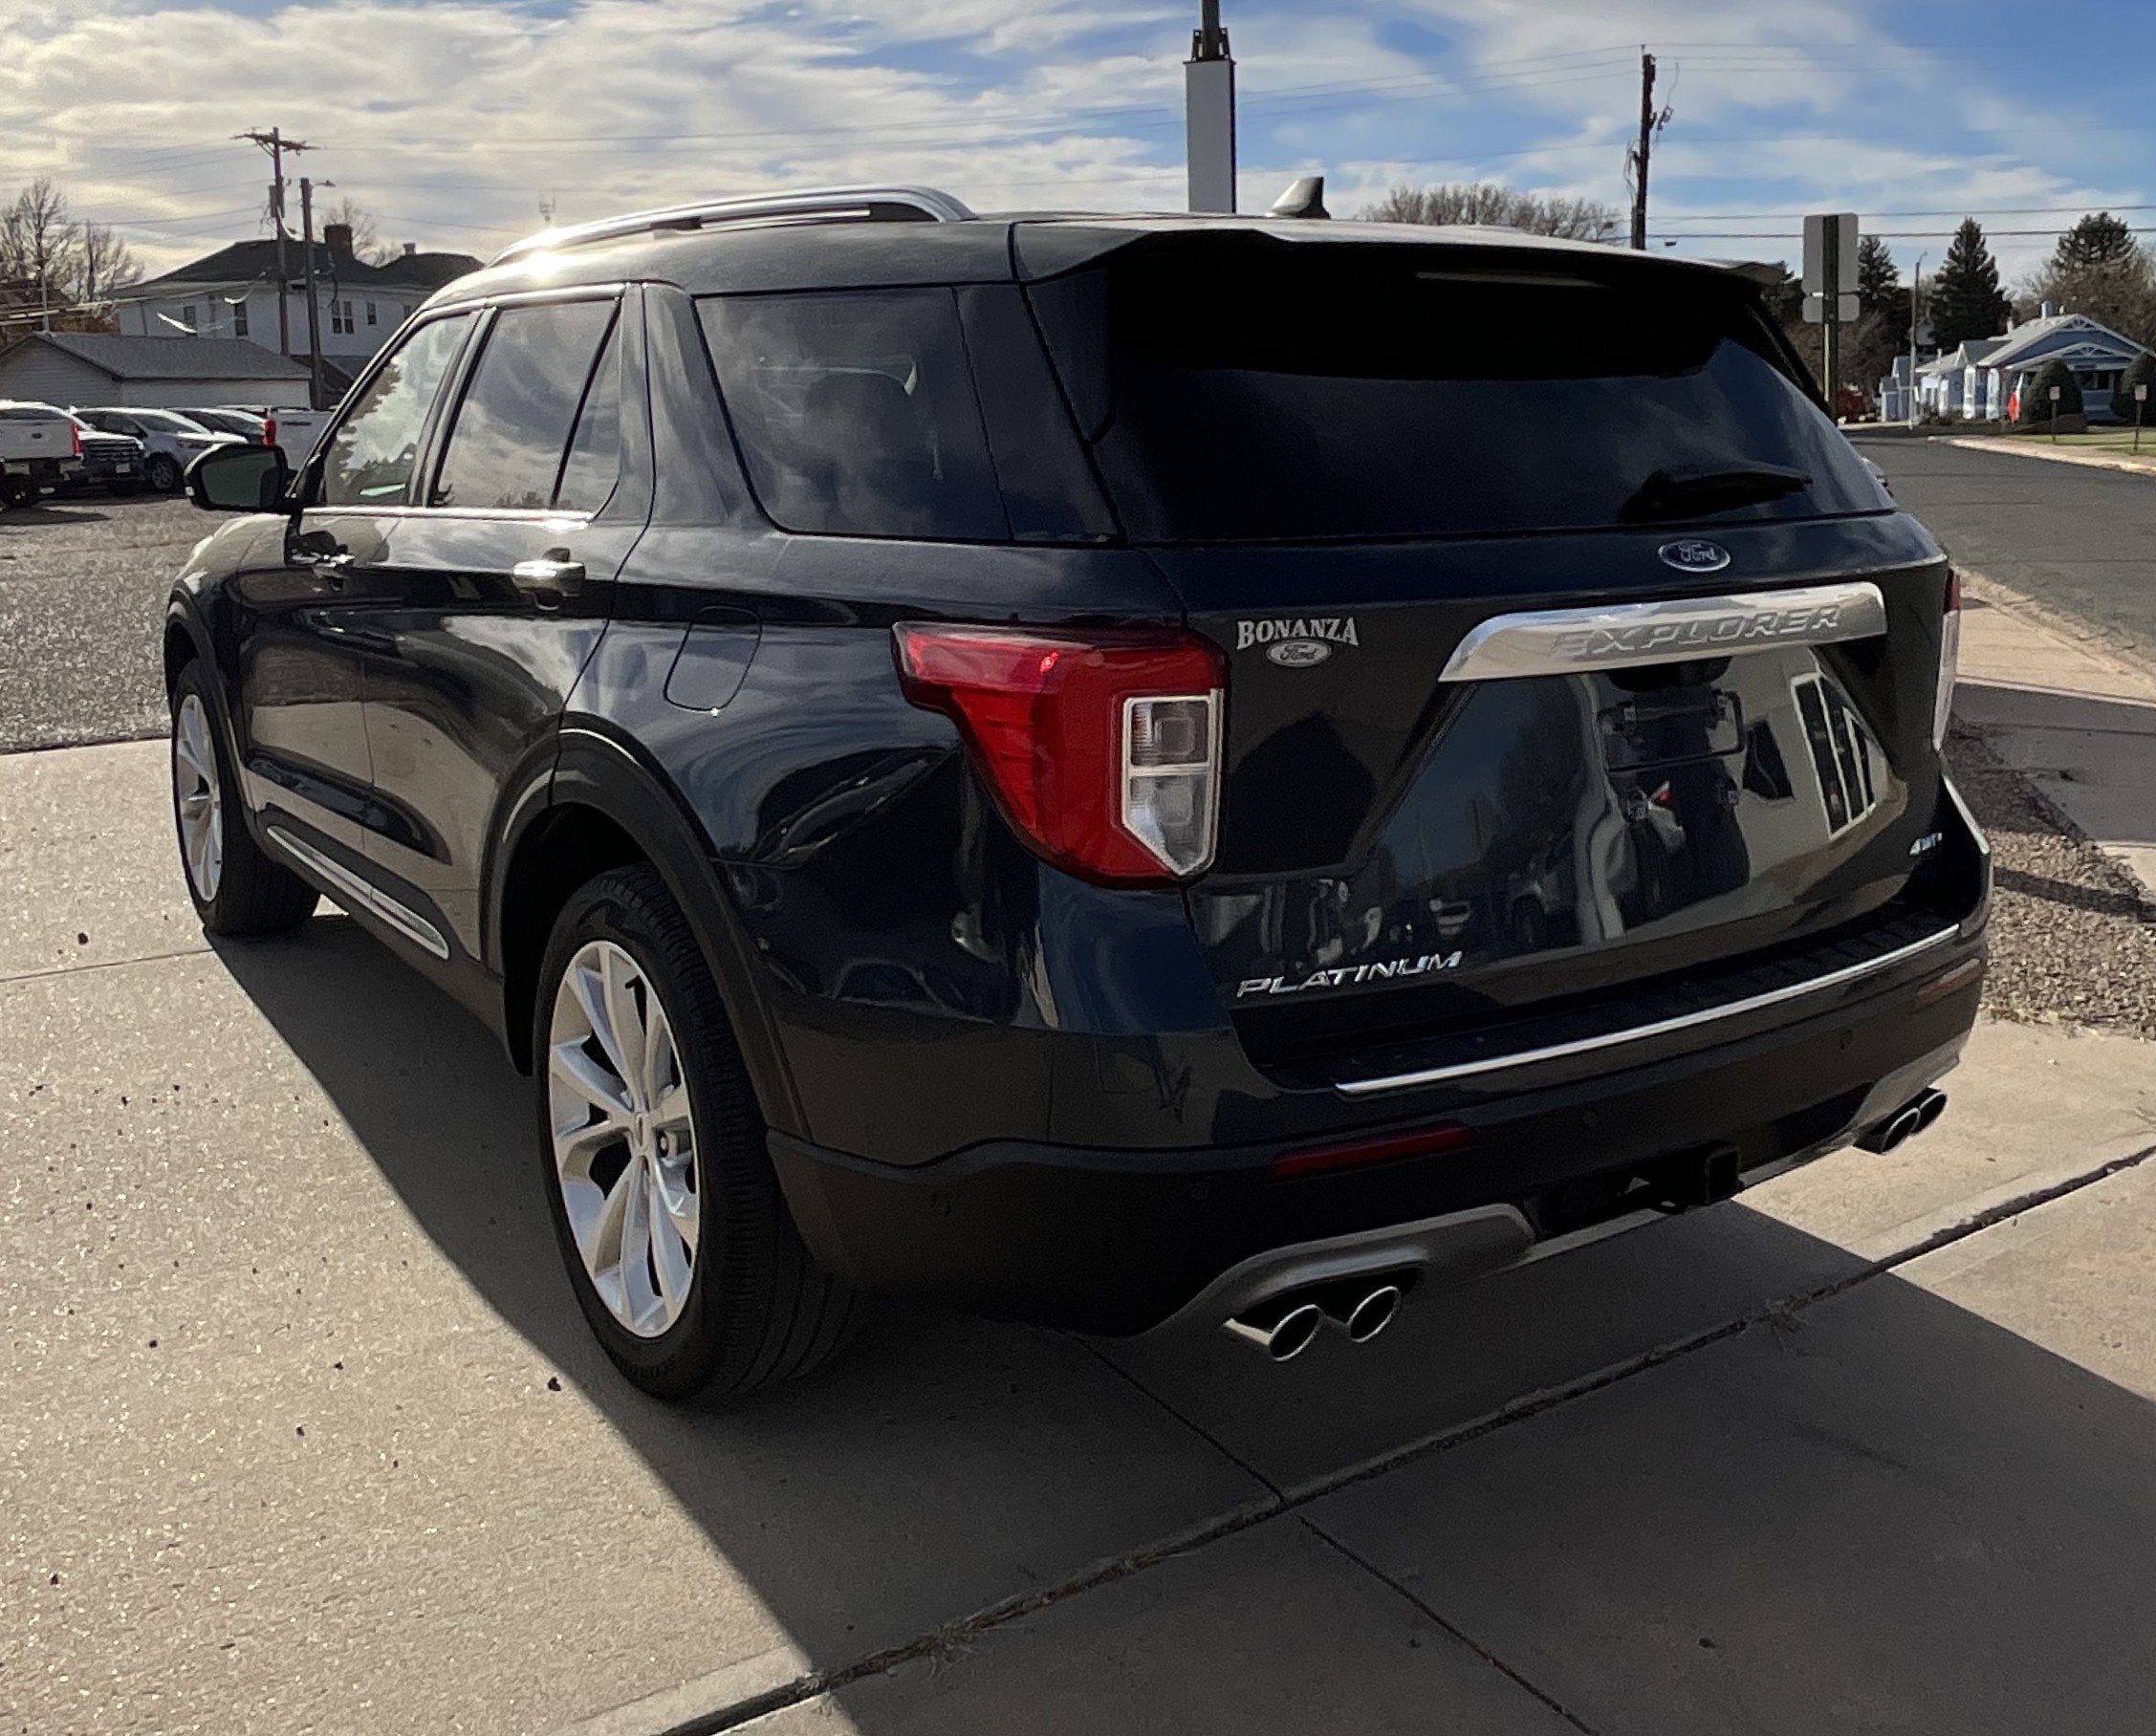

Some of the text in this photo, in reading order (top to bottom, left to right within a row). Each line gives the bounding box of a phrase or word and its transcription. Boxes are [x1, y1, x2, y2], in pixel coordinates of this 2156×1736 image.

[1236, 617, 1360, 650] BONANZA
[1553, 604, 1843, 656] EXPLORER
[1236, 950, 1464, 998] PLATINUM
